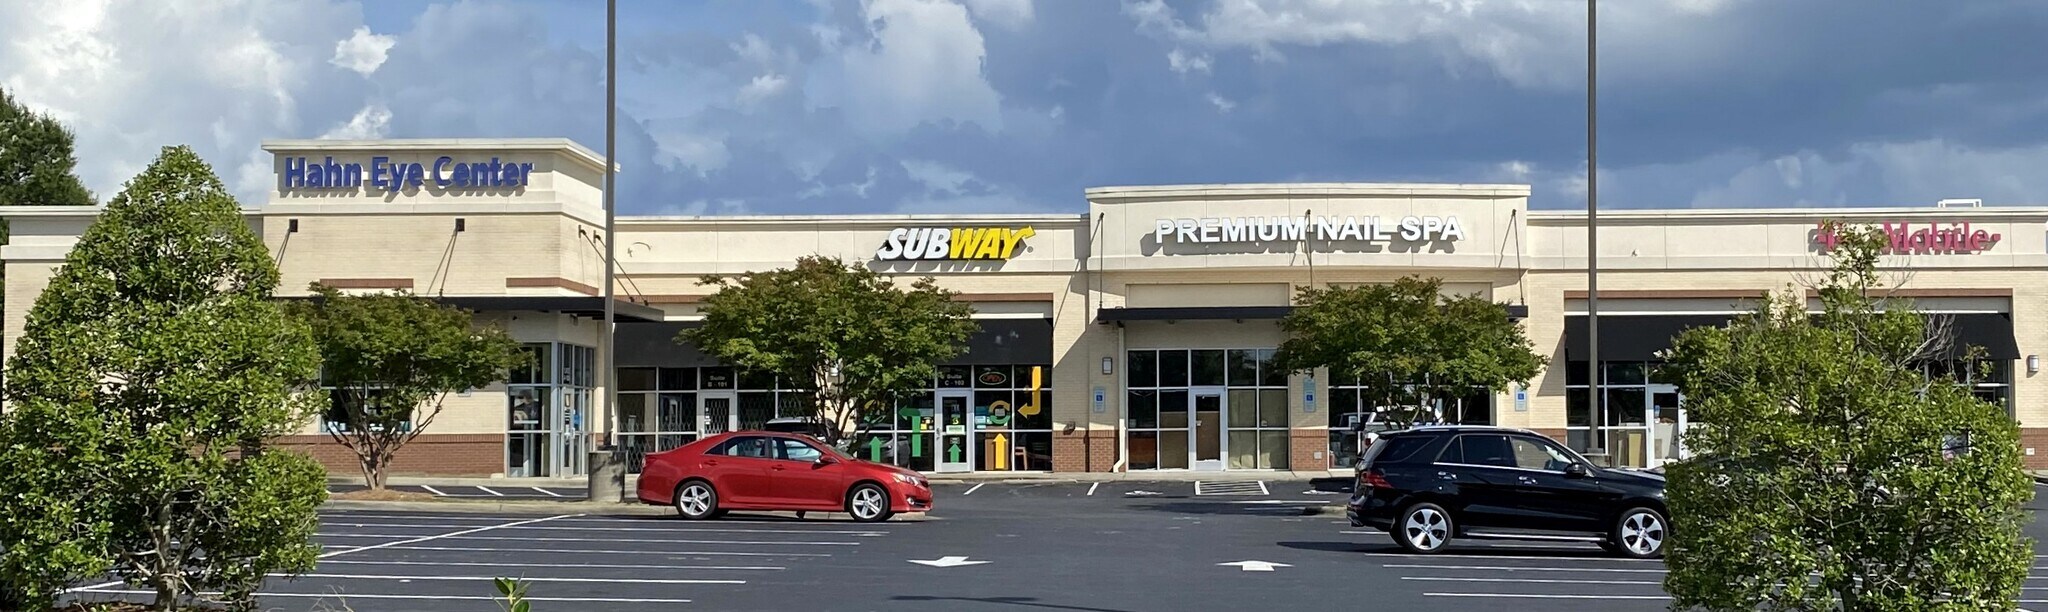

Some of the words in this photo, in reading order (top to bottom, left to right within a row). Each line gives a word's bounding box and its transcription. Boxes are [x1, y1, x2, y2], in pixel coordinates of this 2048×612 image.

[285, 156, 362, 188] Hahn
[371, 156, 424, 193] Eye
[433, 155, 534, 188] Center
[876, 225, 1036, 261] SUBWAY
[1155, 216, 1306, 243] PREMIUM
[1317, 215, 1390, 241] NAIL
[1400, 215, 1465, 241] SPA
